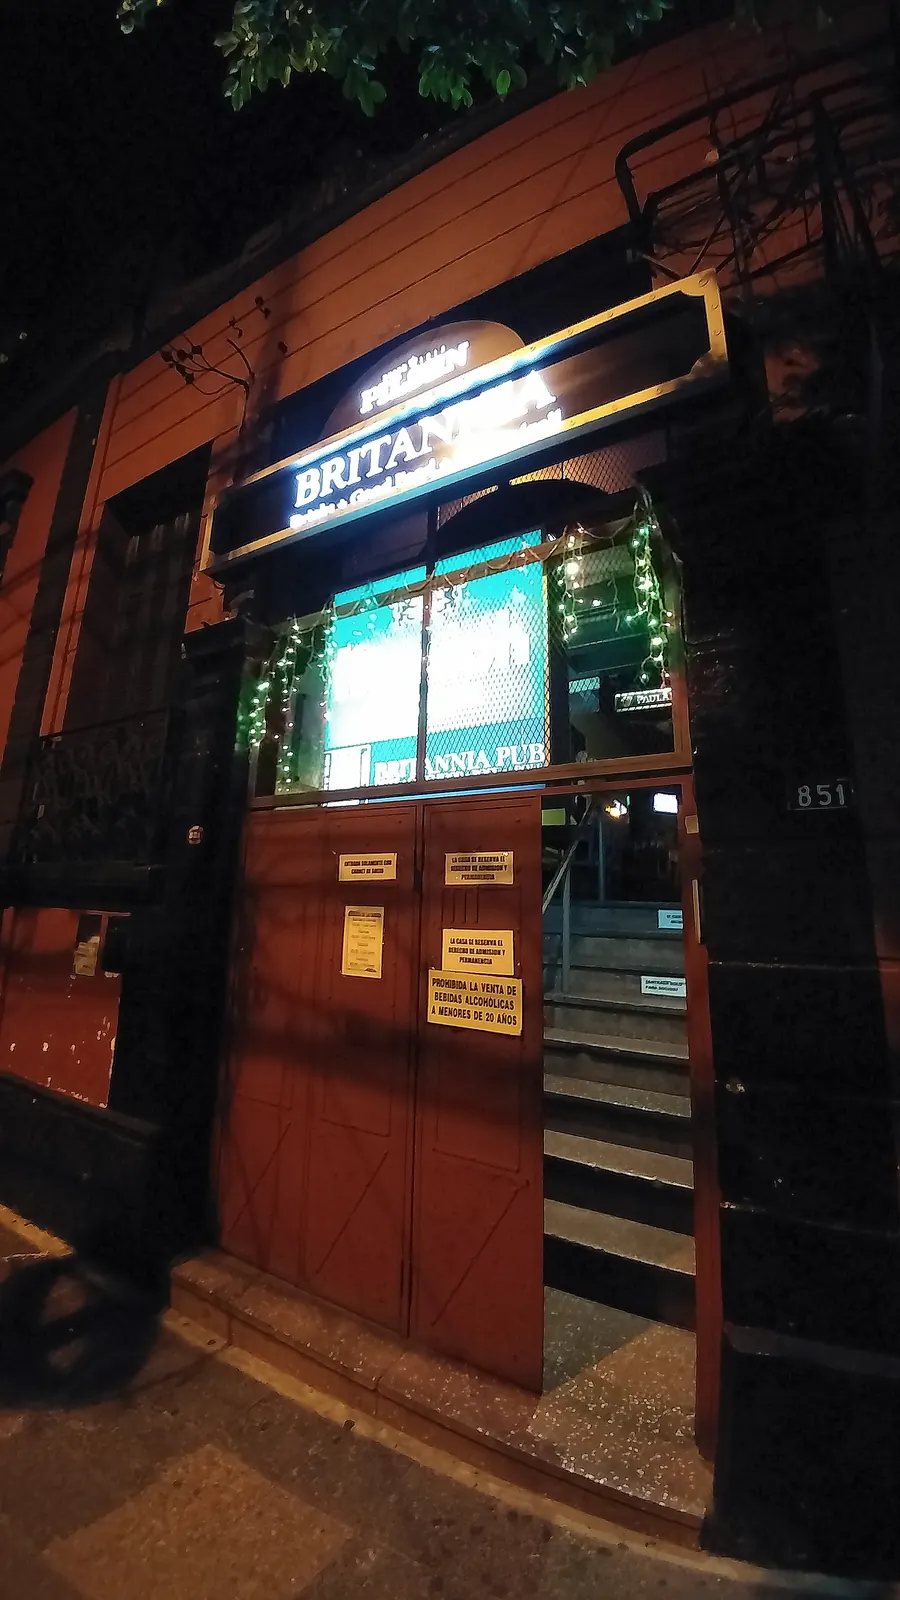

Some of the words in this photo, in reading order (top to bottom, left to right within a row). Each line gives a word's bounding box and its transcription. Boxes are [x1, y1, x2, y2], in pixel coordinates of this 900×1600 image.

[293, 370, 557, 508] BRITANA
[496, 743, 545, 767] PUB
[797, 784, 845, 807] 851
[459, 956, 493, 964] PERMANENCIA
[432, 977, 467, 991] PROHIBIDA
[469, 981, 478, 992] LA
[481, 982, 504, 995] VENTA
[507, 985, 517, 996] DE
[434, 991, 462, 1004] BEBIDAS
[431, 1005, 436, 1015] A
[438, 1006, 471, 1020] MENORES
[474, 1010, 483, 1021] DE
[485, 1012, 494, 1023] 20
[497, 1013, 517, 1026] AÑOS
